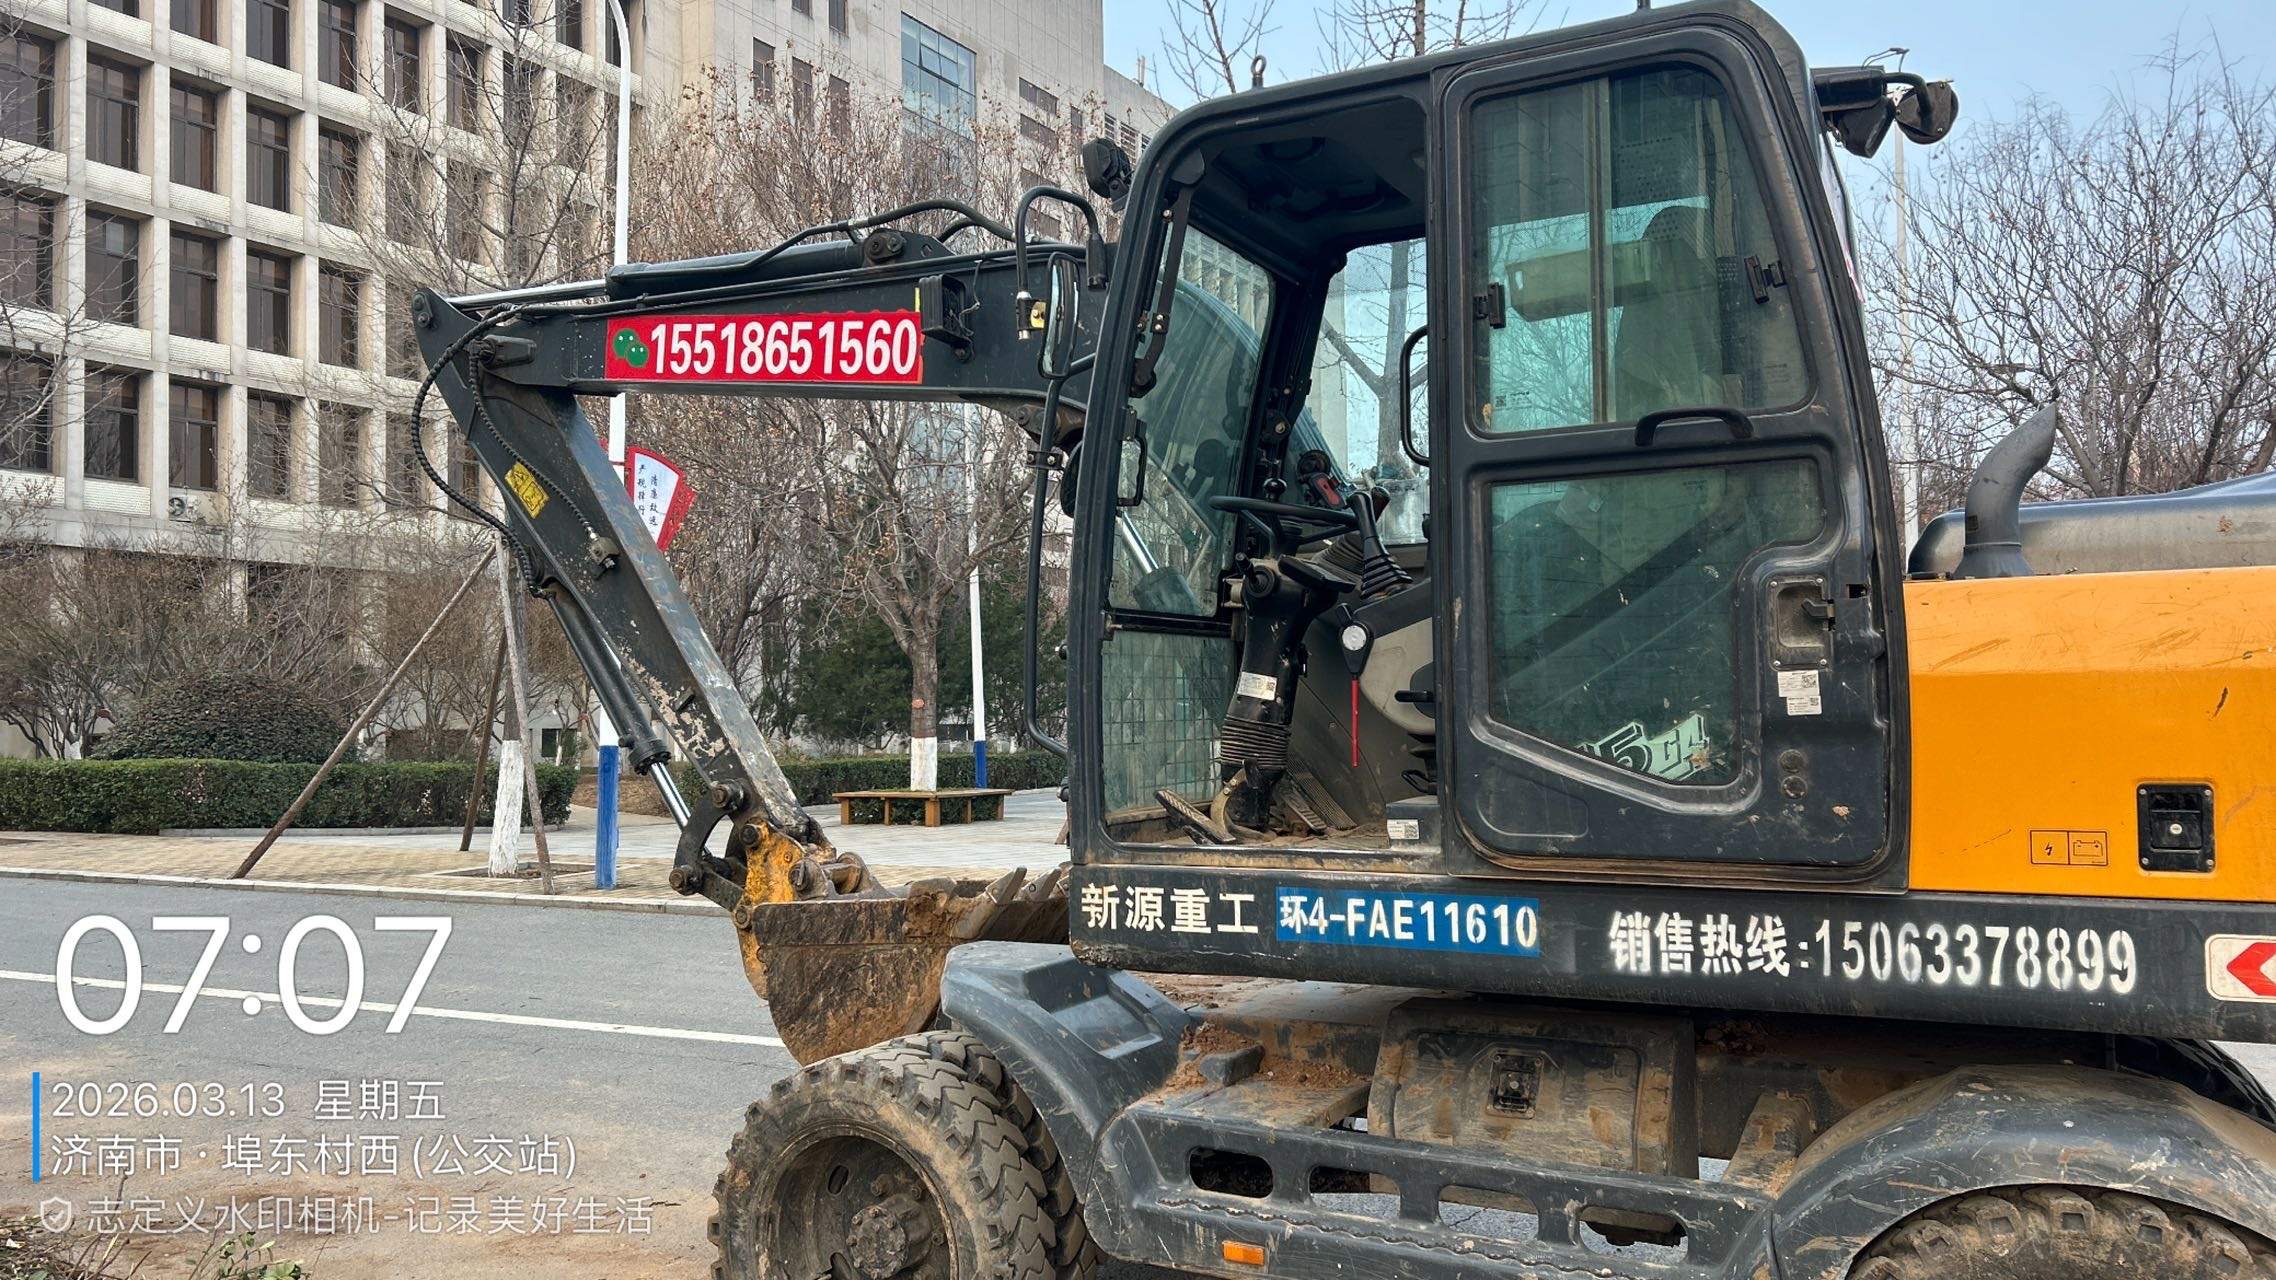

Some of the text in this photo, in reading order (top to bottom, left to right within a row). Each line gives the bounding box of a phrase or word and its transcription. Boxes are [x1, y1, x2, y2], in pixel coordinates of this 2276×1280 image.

[651, 318, 917, 375] 15518651560
[1080, 883, 1259, 935] 新源重工
[1279, 894, 1538, 949] 环4-FAE11610
